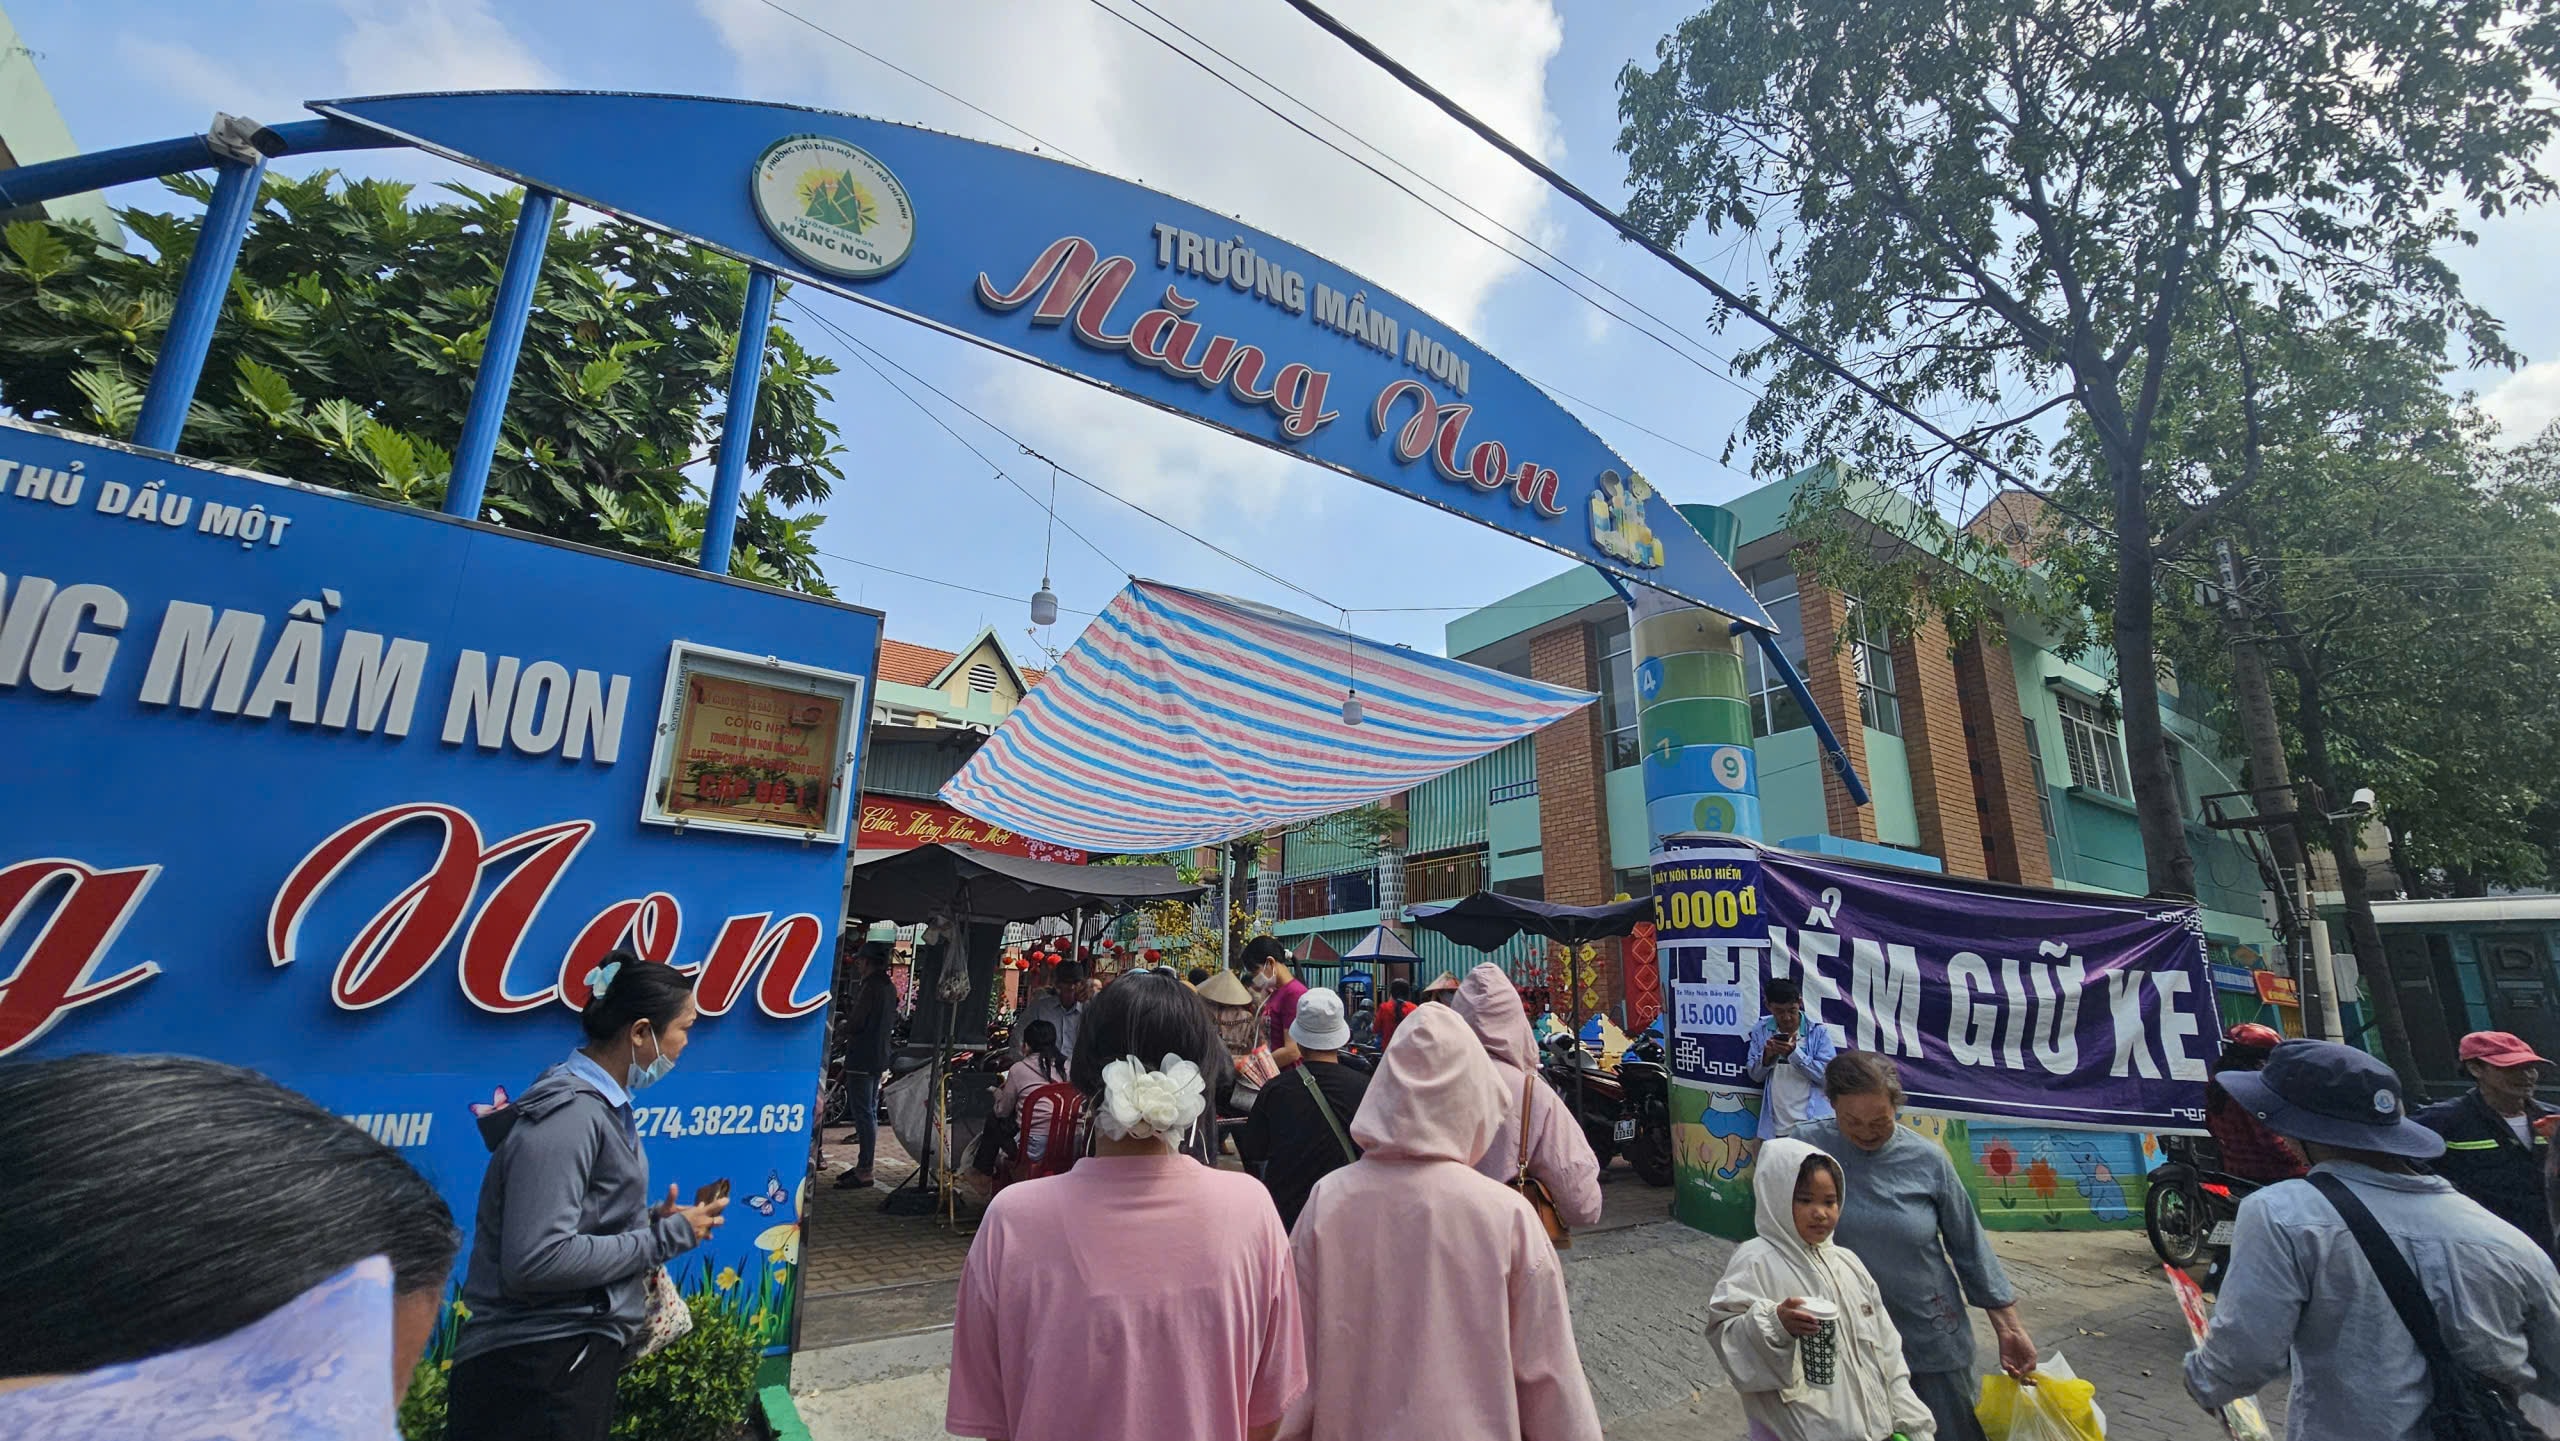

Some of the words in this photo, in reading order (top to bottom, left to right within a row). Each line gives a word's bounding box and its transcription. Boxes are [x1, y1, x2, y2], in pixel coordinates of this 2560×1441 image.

[896, 197, 909, 220] MINH
[780, 221, 836, 250] MĂNG
[840, 243, 882, 266] NON
[1154, 221, 1306, 314] TRƯỜNG
[1315, 282, 1398, 357] MẦM
[1406, 328, 1470, 396] NON
[976, 236, 1340, 439] Măng
[1375, 379, 1568, 516] Non
[198, 504, 292, 549] MỘT
[139, 588, 430, 736] MẦM
[441, 649, 632, 765] NON
[1643, 669, 1656, 691] 4
[724, 715, 761, 731] CÔNG
[1722, 756, 1740, 778] 9
[861, 806, 899, 833] Chúc
[896, 811, 943, 843] Mừng
[939, 816, 976, 841] Năm
[975, 823, 1013, 847] Mới
[1669, 867, 1688, 882] NÓN
[1690, 864, 1712, 880] BẢO
[1714, 864, 1741, 880] HIỂM
[267, 801, 832, 1019] Non
[1680, 1003, 1737, 1026] 15.000
[1948, 940, 2085, 1076] GIỮ
[2103, 969, 2208, 1083] XE
[633, 1104, 805, 1139] 274.3822.633
